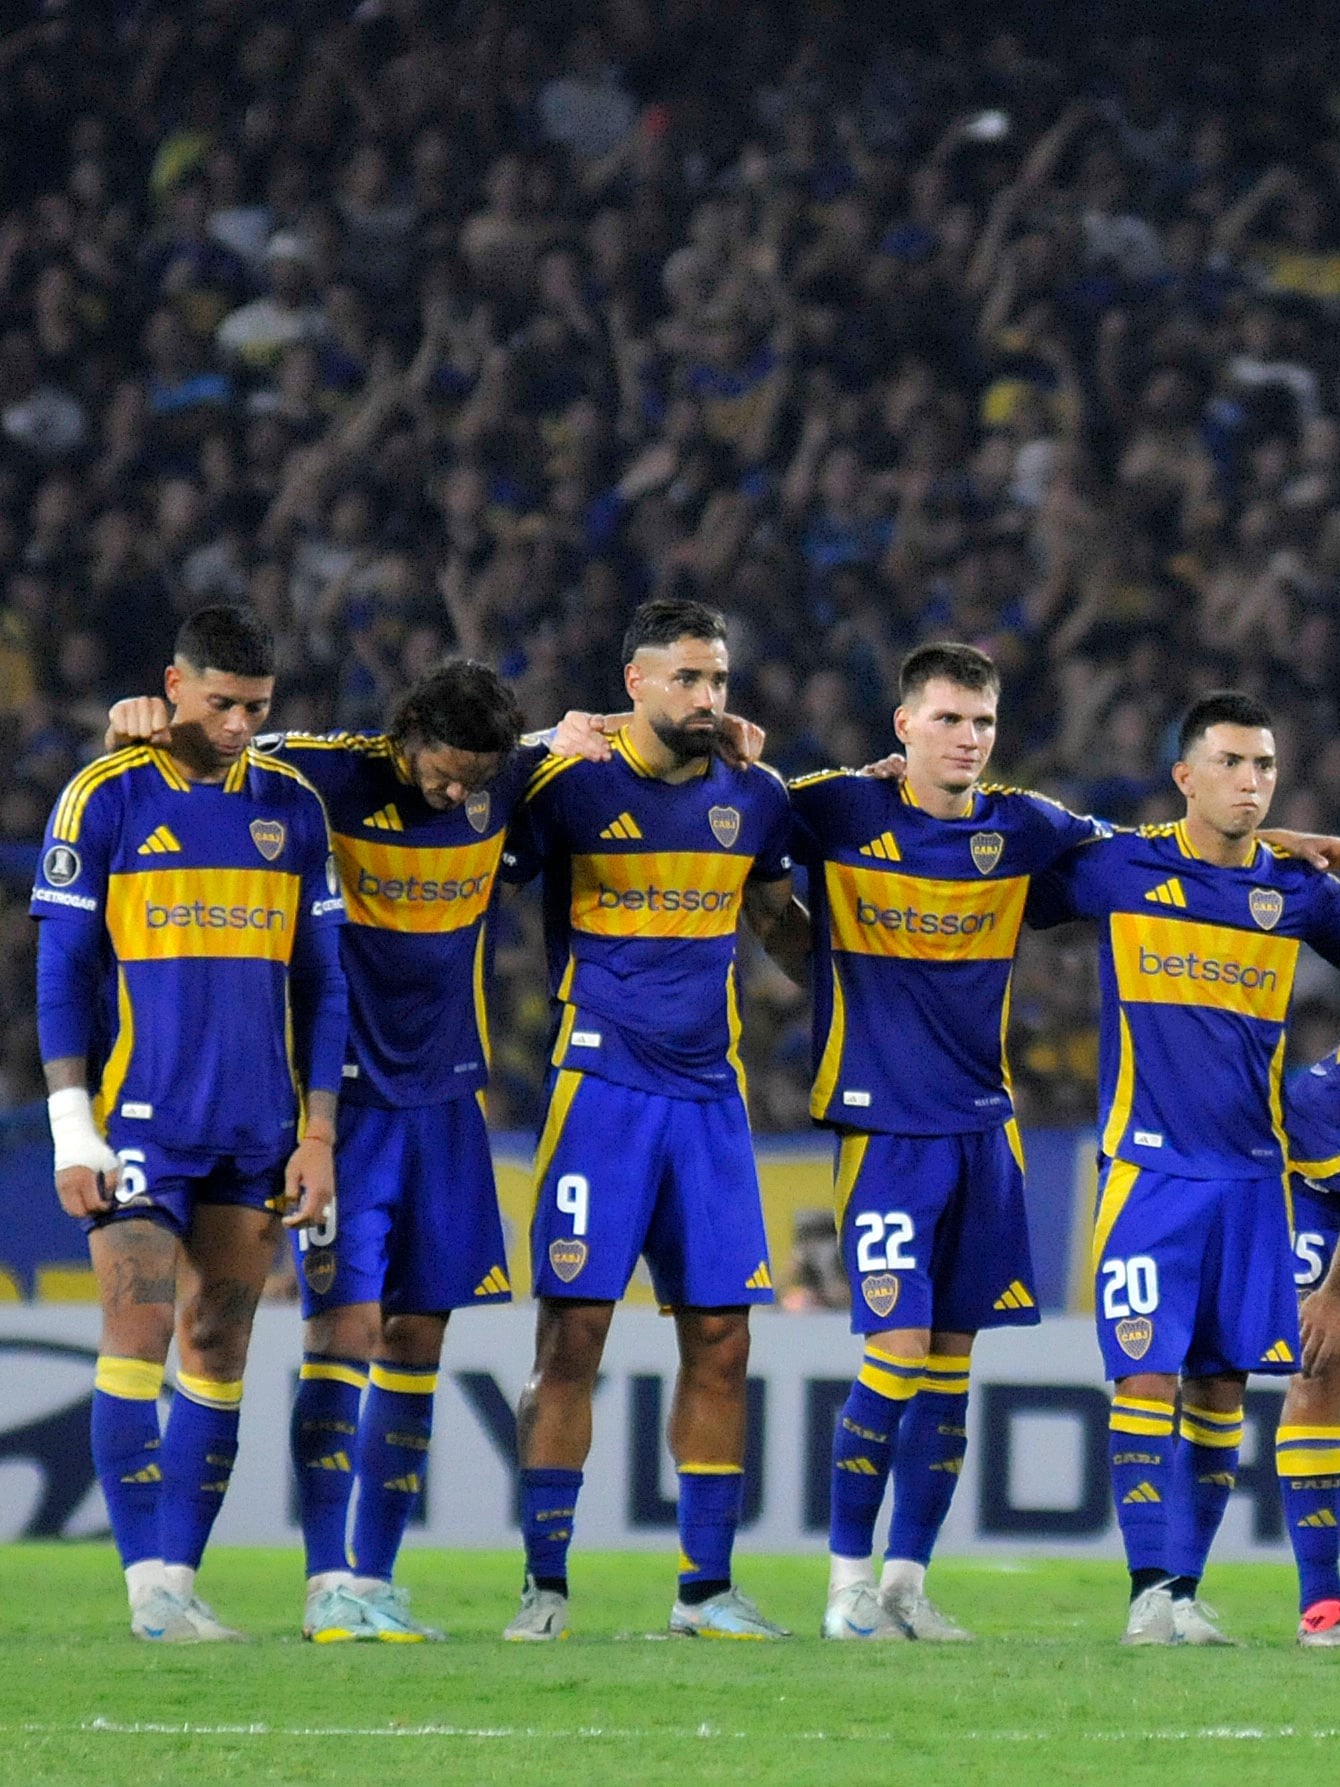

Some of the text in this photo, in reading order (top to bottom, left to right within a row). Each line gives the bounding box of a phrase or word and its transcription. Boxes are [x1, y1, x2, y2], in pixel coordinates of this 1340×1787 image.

[36, 888, 97, 911] CETROGAR
[145, 900, 286, 931] betsson
[857, 898, 995, 936] betsson
[1139, 947, 1277, 992] betsson
[556, 1174, 588, 1236] 9
[855, 1212, 916, 1272] 22
[867, 1287, 893, 1299] CABJ
[1102, 1256, 1159, 1319] 20
[1121, 1331, 1147, 1342] CABJ
[1113, 1453, 1160, 1465] CABJ
[1290, 1479, 1340, 1490] CABJ
